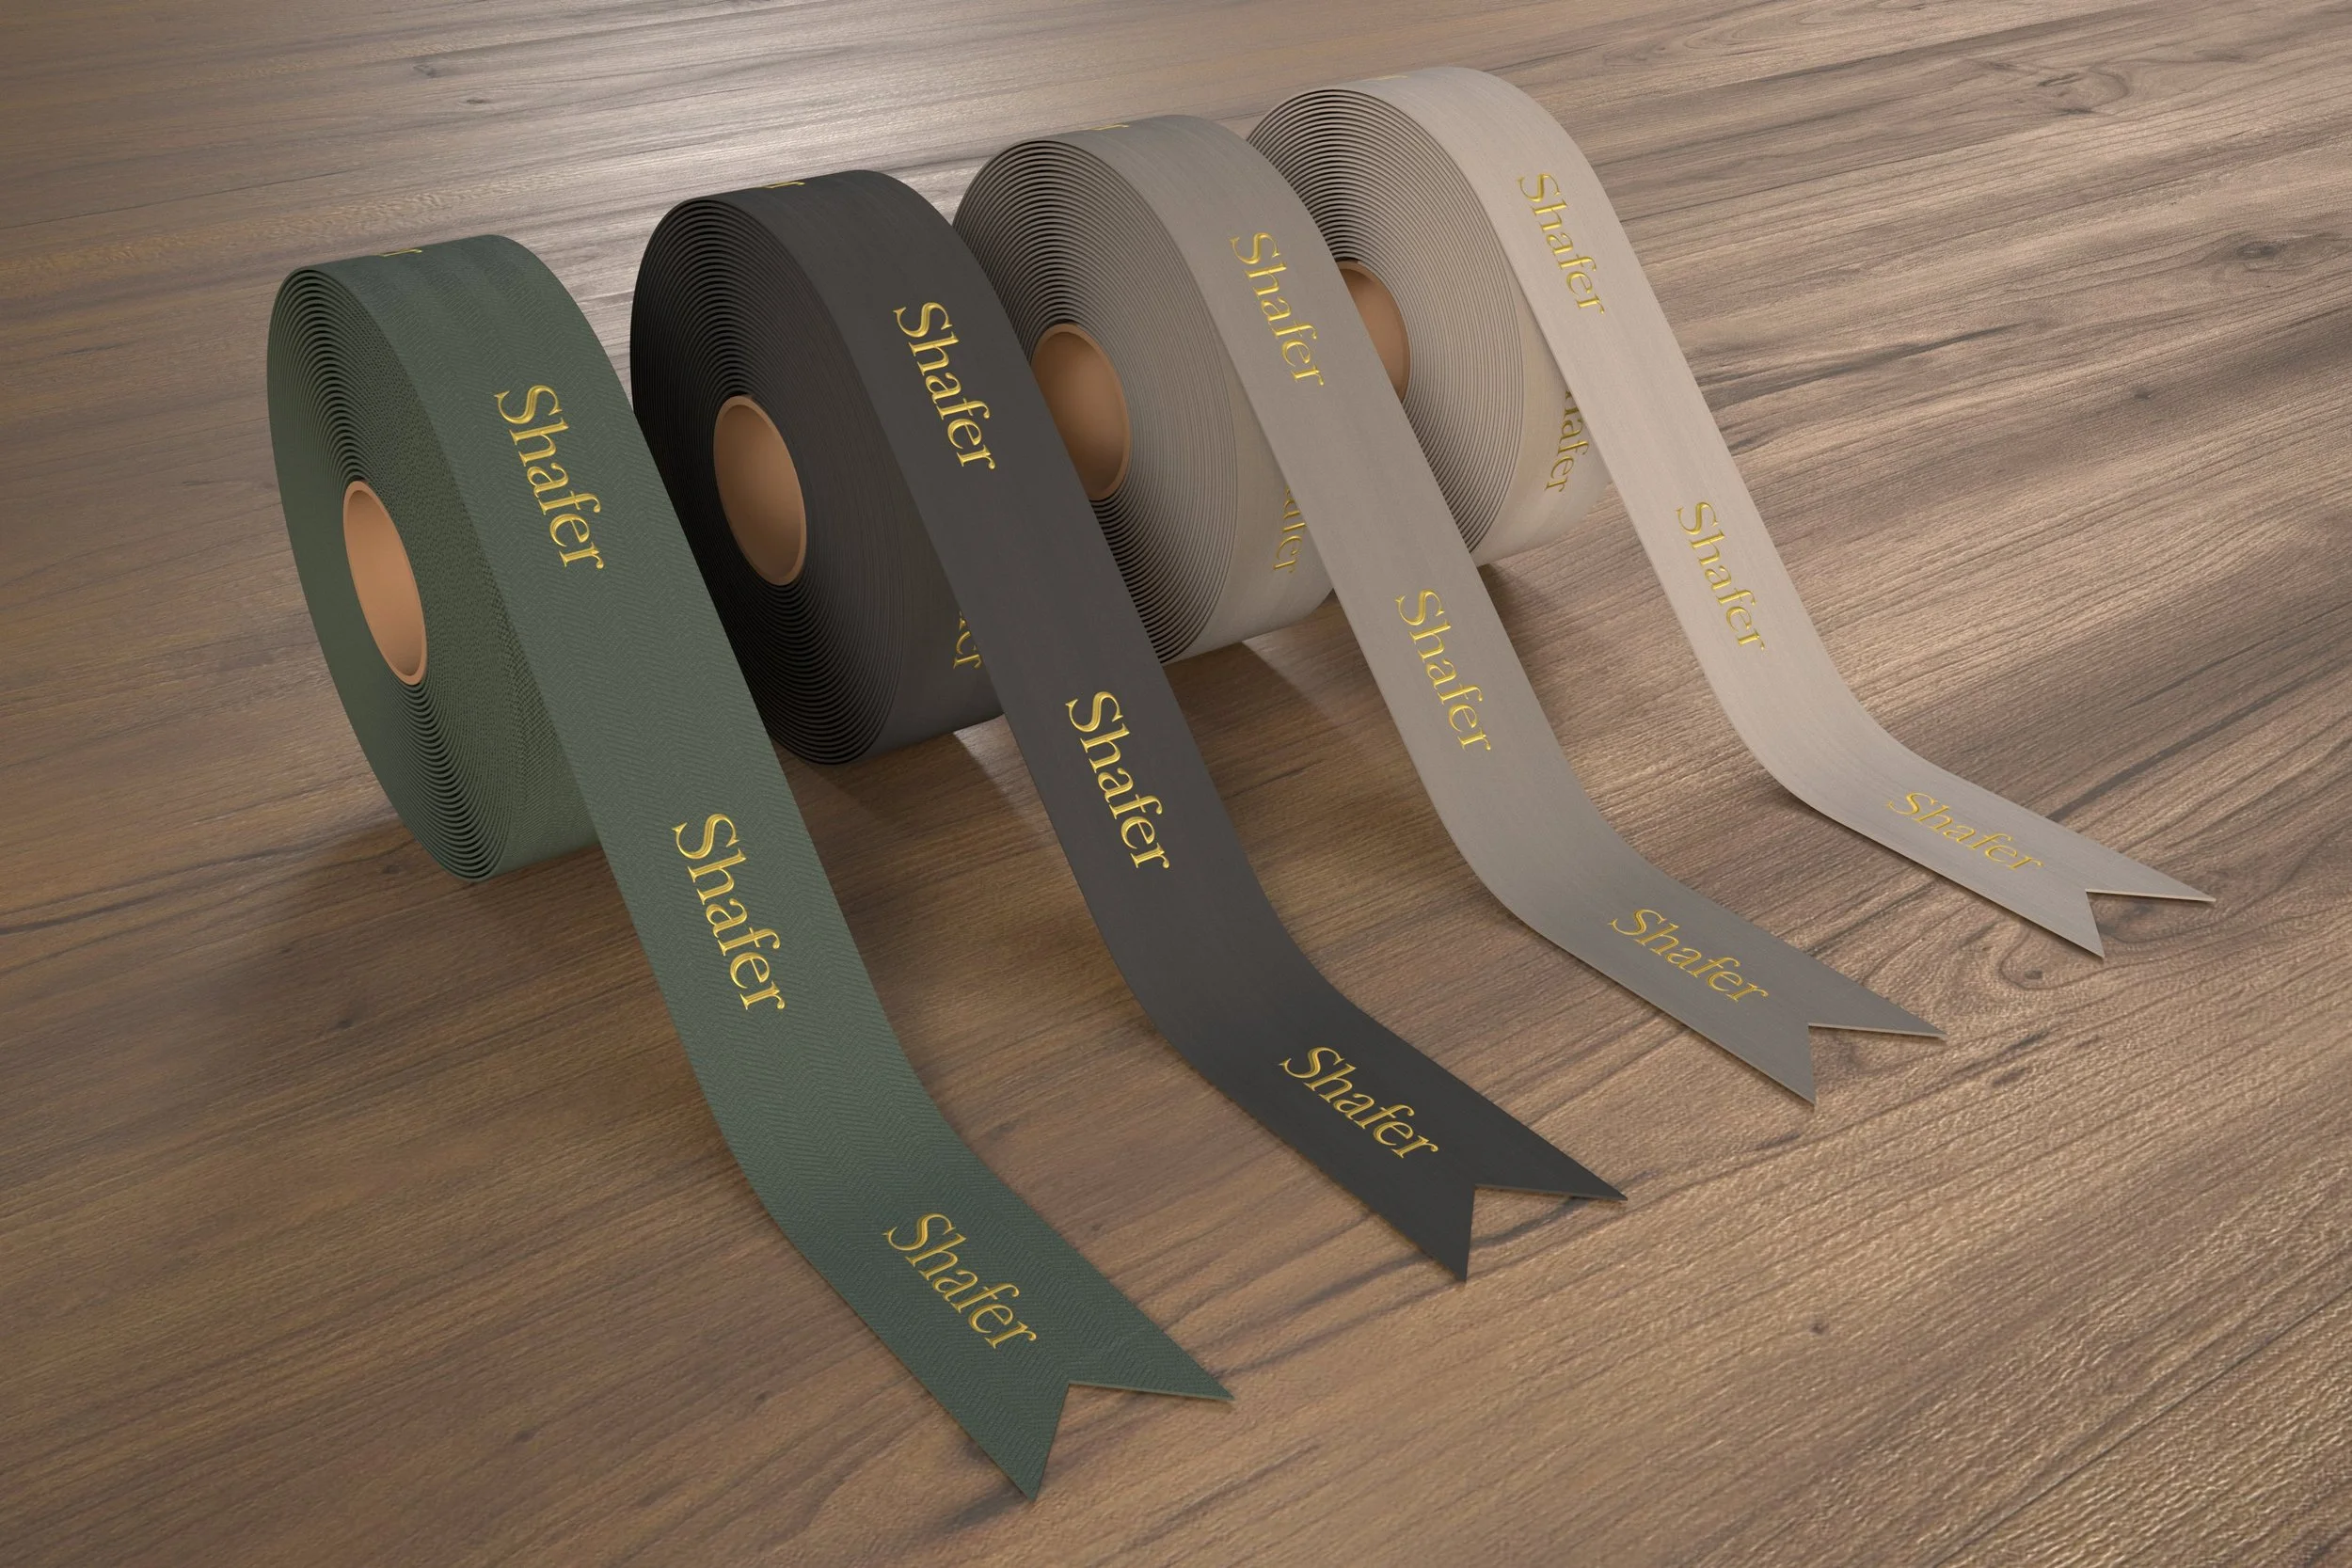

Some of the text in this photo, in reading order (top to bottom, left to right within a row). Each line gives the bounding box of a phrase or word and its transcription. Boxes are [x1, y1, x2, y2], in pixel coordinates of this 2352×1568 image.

[1231, 232, 1325, 387] Shafer
[1520, 172, 1604, 312] Shafer
[894, 302, 995, 471] Shafer
[1545, 391, 1589, 492] afer
[495, 385, 604, 570] Shafer
[1677, 501, 1765, 648] Shafer
[1396, 590, 1491, 752] Shafer
[1066, 691, 1168, 871] Shafer
[1886, 793, 2042, 872] Shafer
[673, 813, 786, 1012] Shafer
[1611, 908, 1768, 1005] Shafer
[1279, 1046, 1438, 1161] Shafer
[884, 1213, 1037, 1348] Shafer
